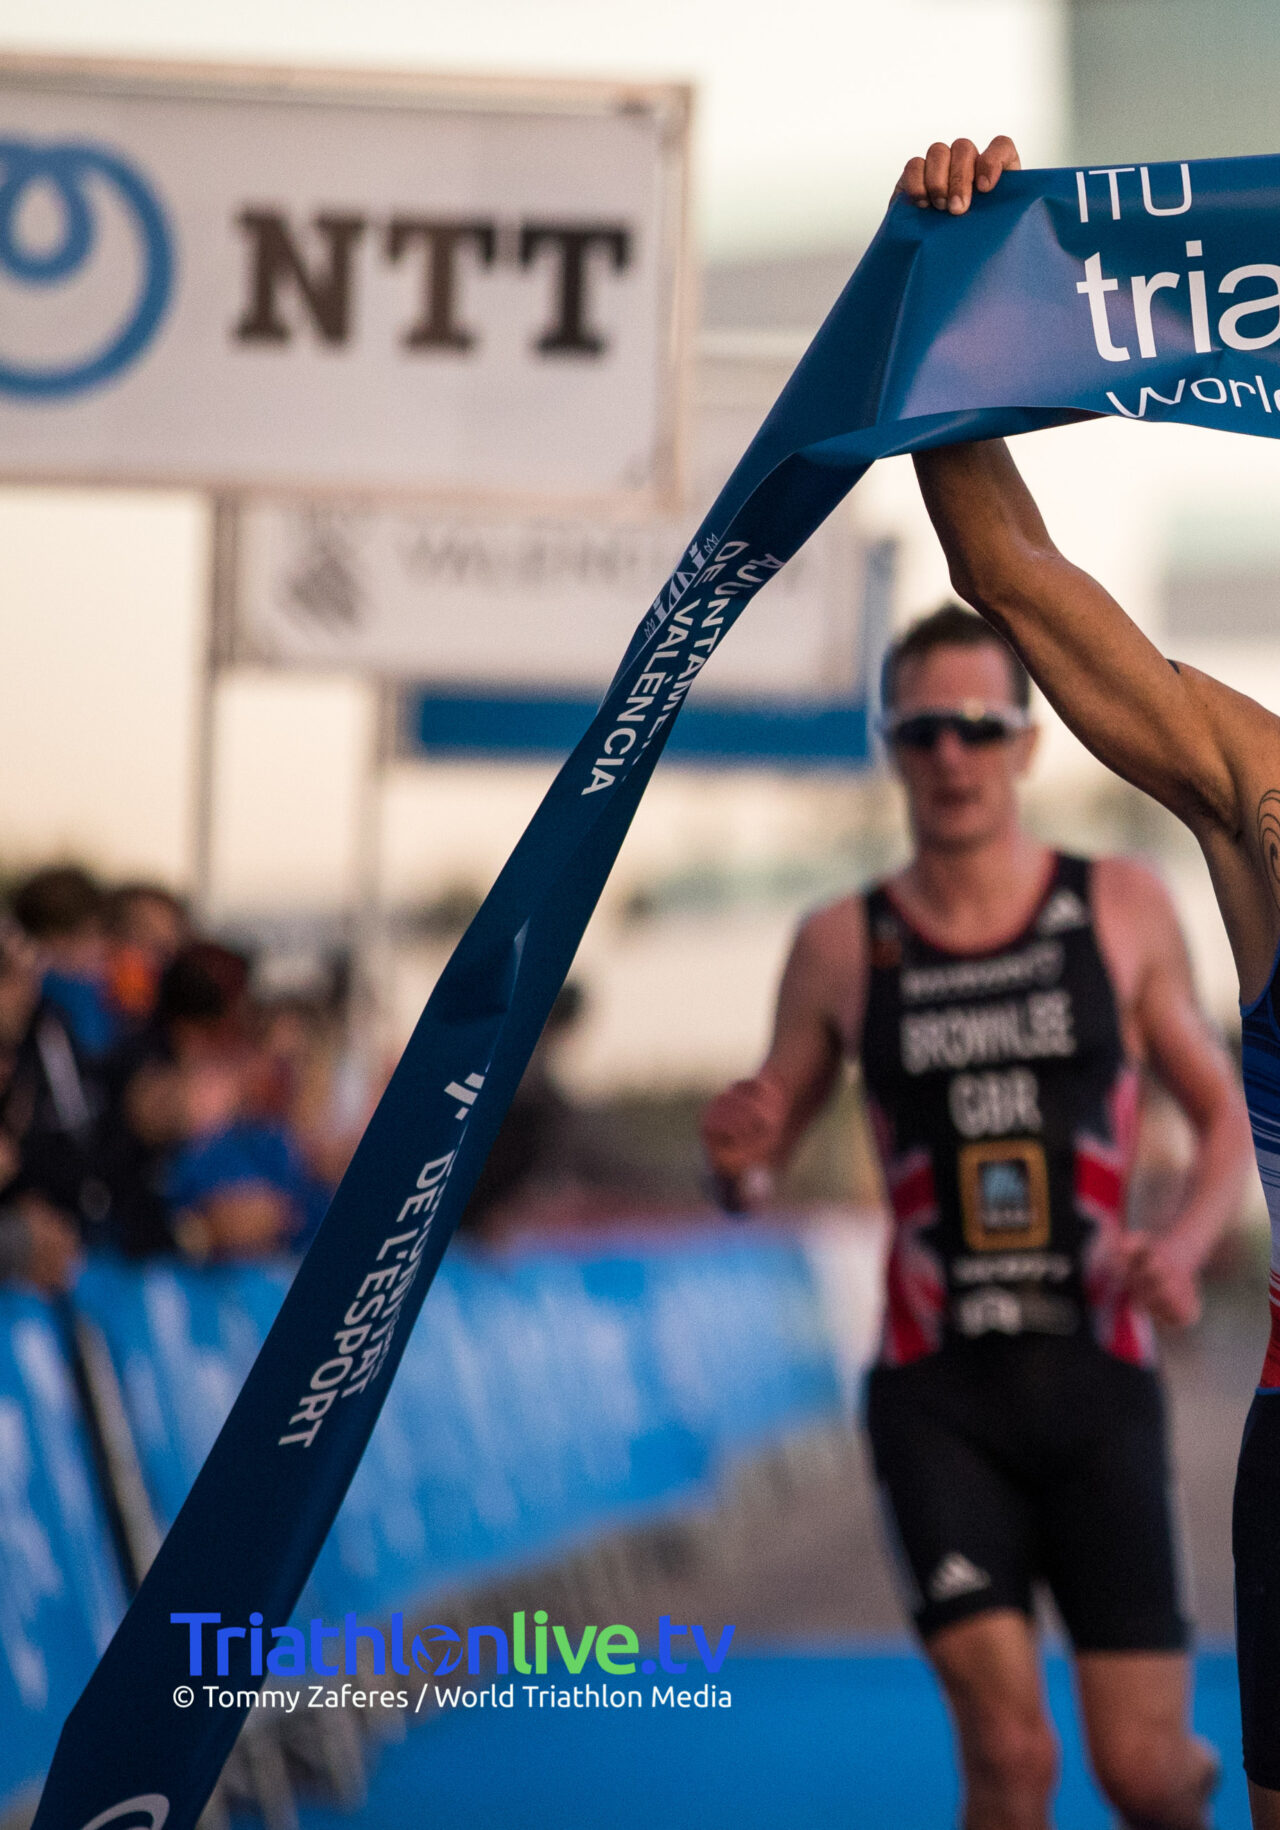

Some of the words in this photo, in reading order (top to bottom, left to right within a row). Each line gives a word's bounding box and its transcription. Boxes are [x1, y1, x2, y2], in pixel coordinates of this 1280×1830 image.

[1075, 162, 1194, 224] ITU
[233, 205, 631, 358] NTT
[692, 540, 750, 589] DE
[396, 1149, 456, 1223] DE
